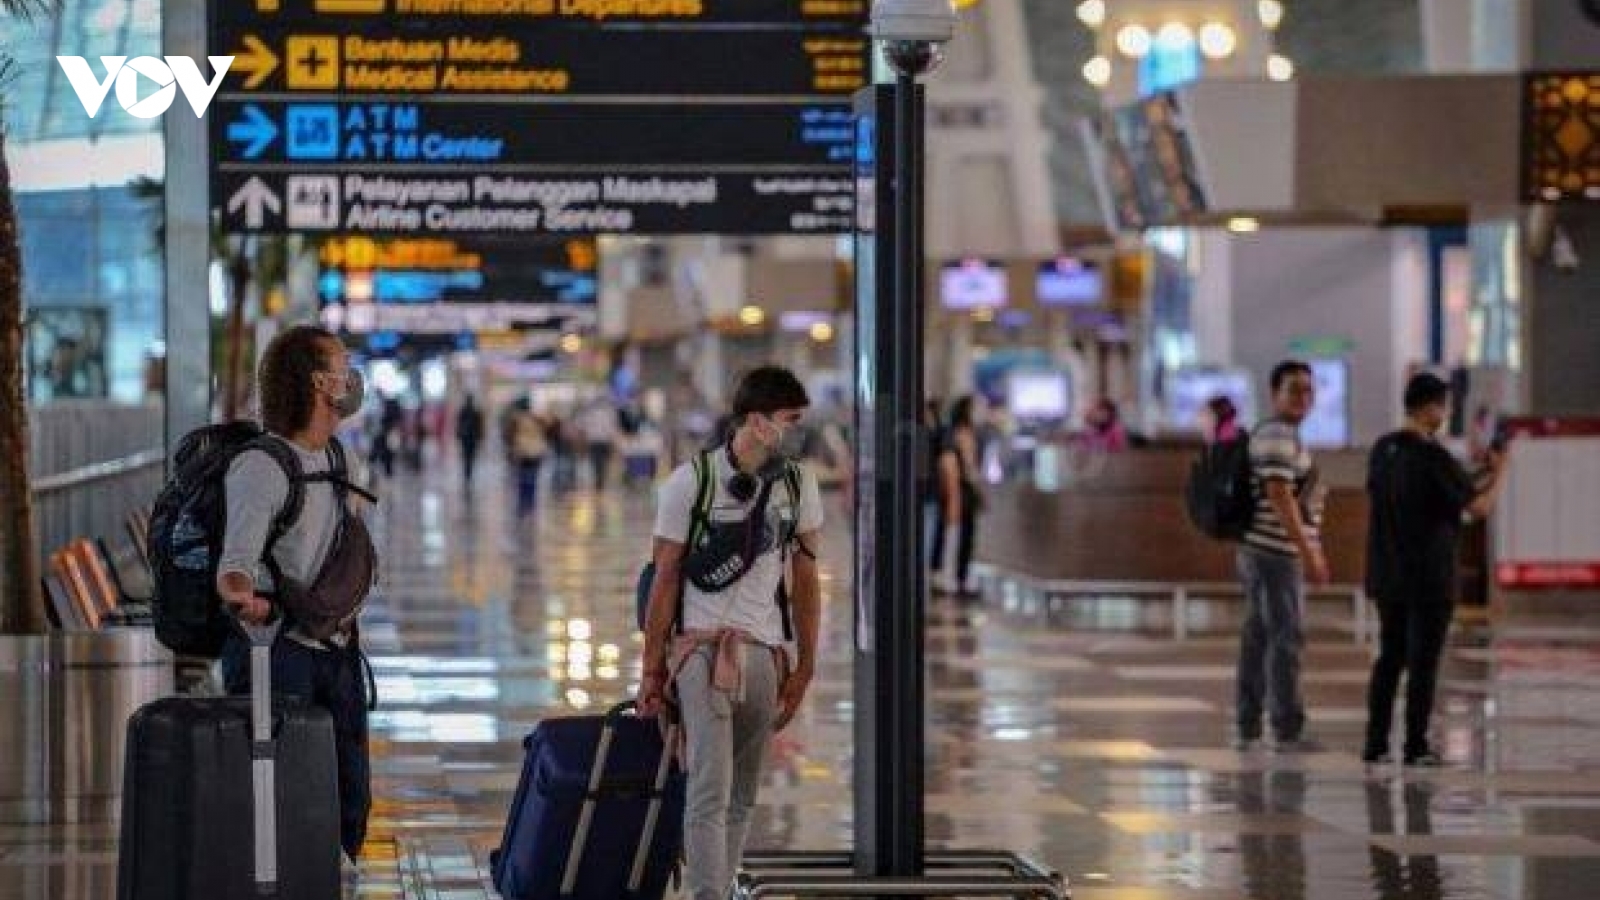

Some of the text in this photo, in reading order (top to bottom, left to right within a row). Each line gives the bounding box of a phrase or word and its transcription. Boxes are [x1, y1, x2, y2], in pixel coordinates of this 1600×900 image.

[345, 65, 568, 91] Medical Assistance
[422, 133, 504, 160] Center
[345, 174, 470, 206] Pelayanan
[474, 175, 600, 208] Pelanggan
[603, 175, 717, 209] Maskapai
[346, 203, 633, 231] Airline Customer Service
